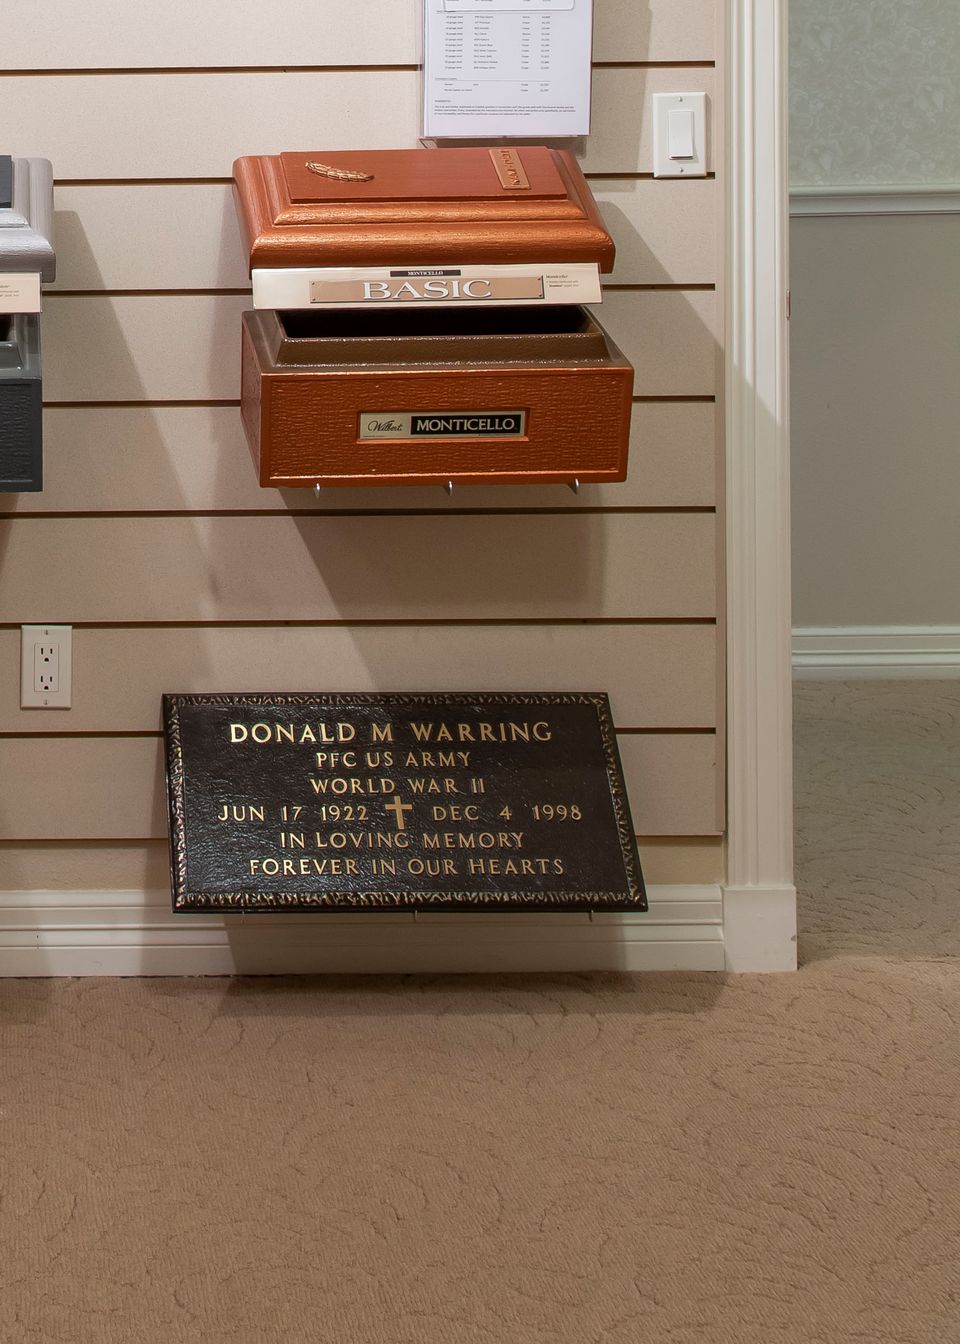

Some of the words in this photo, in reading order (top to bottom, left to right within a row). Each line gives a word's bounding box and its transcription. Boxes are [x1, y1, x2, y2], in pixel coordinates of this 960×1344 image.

[362, 280, 491, 300] BASIC
[416, 418, 515, 432] MONTICELLO
[230, 722, 357, 743] DONALD
[371, 723, 394, 743] M
[411, 721, 553, 743] WARRING
[316, 752, 358, 768] PFC
[367, 752, 394, 768] US
[405, 751, 472, 768] ARMY
[310, 778, 396, 795] WORLD
[407, 778, 457, 794] WAR
[472, 778, 485, 794] II
[217, 805, 266, 822] JUN
[281, 805, 303, 822] 17
[321, 804, 369, 822] 1922
[433, 804, 480, 822] DEC
[499, 805, 513, 821] 4
[531, 804, 583, 821] 1998
[280, 832, 305, 849] IN
[316, 832, 410, 849] LOVING
[422, 831, 525, 849] MEMORY
[249, 859, 359, 876] FOREVER
[372, 859, 397, 876] IN
[408, 859, 460, 876] OUR
[470, 858, 565, 875] HEARTS
